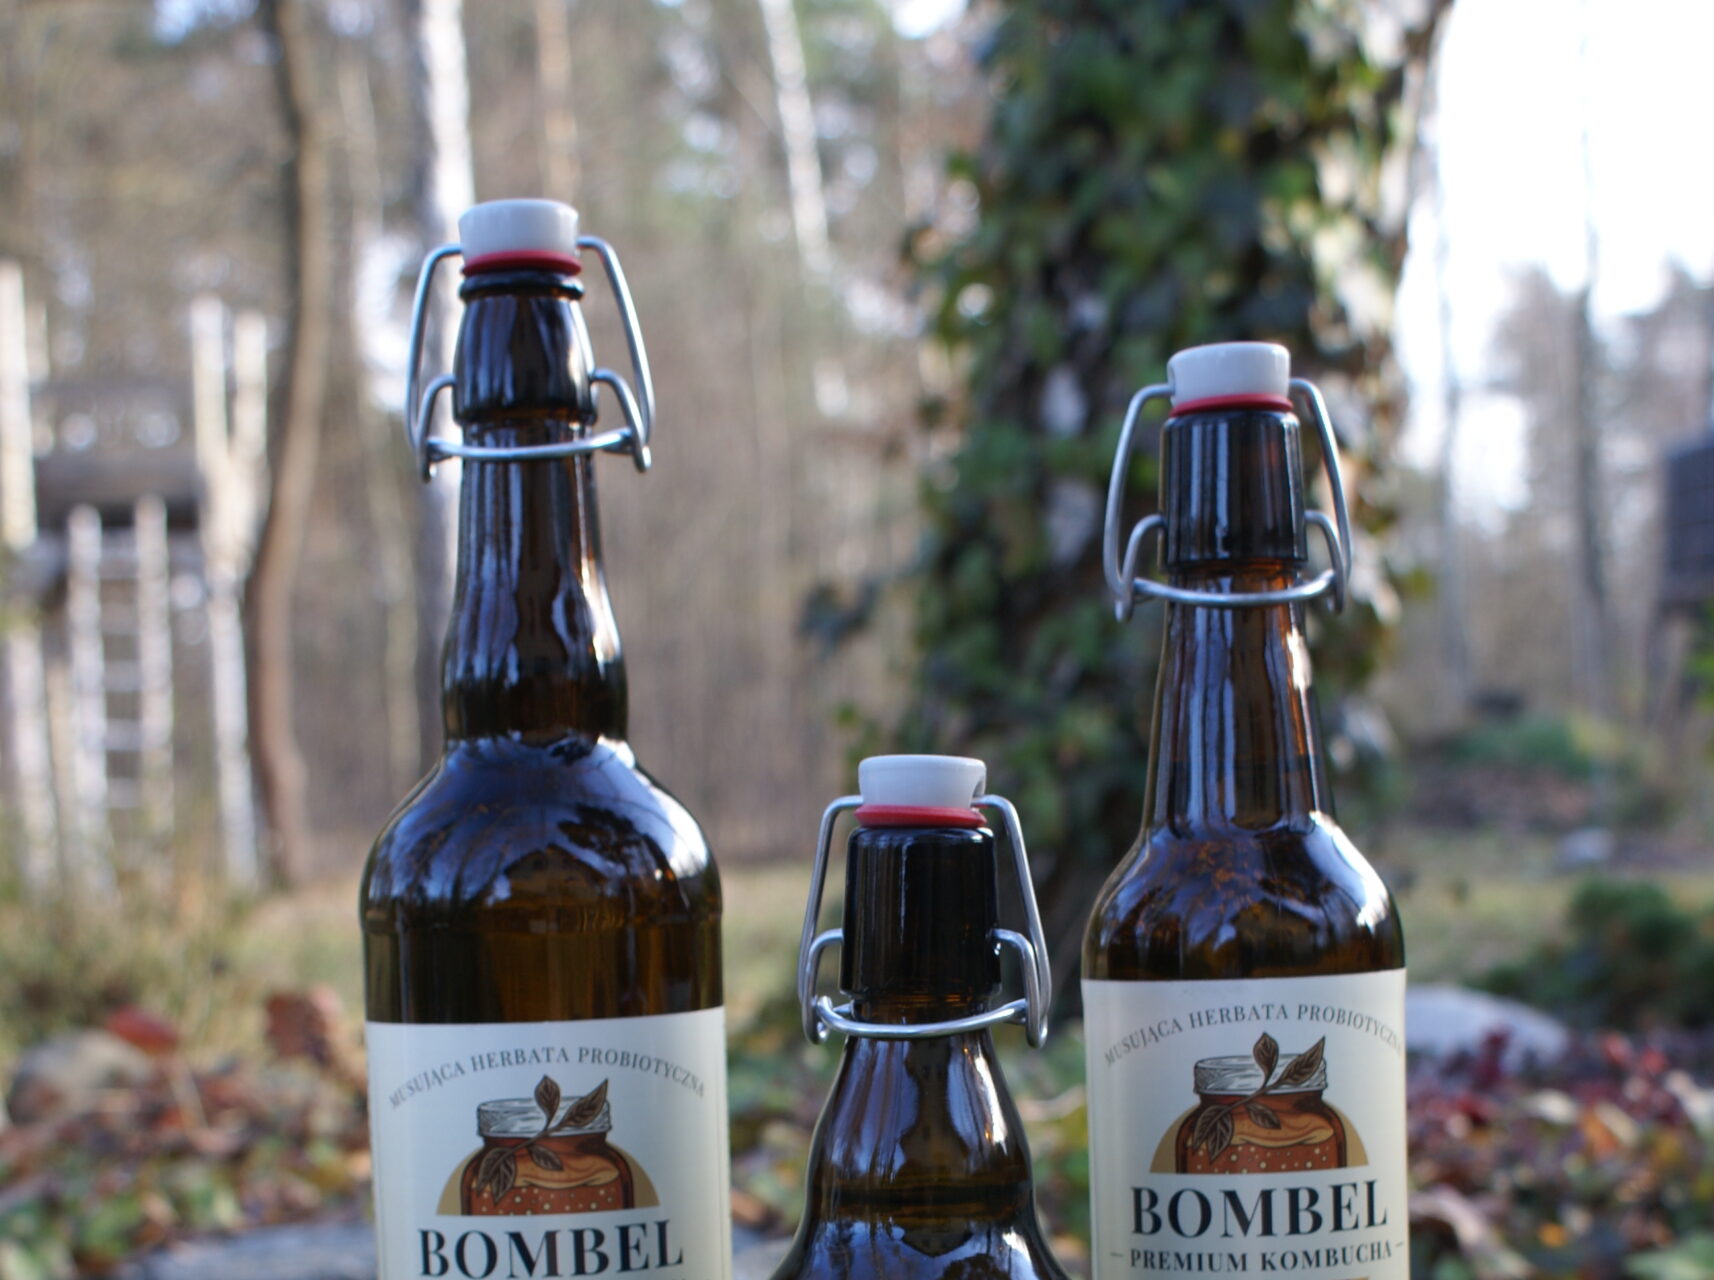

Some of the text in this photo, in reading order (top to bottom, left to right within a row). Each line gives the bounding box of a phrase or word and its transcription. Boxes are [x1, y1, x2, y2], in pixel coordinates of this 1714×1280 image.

[1190, 1003, 1288, 1029] HERBATA
[471, 1046, 569, 1072] HERBATA
[1131, 1179, 1388, 1239] BOMBEL
[418, 1219, 684, 1280] BOMBEL
[1130, 1239, 1392, 1273] PREMIUM KOMBUCHA
